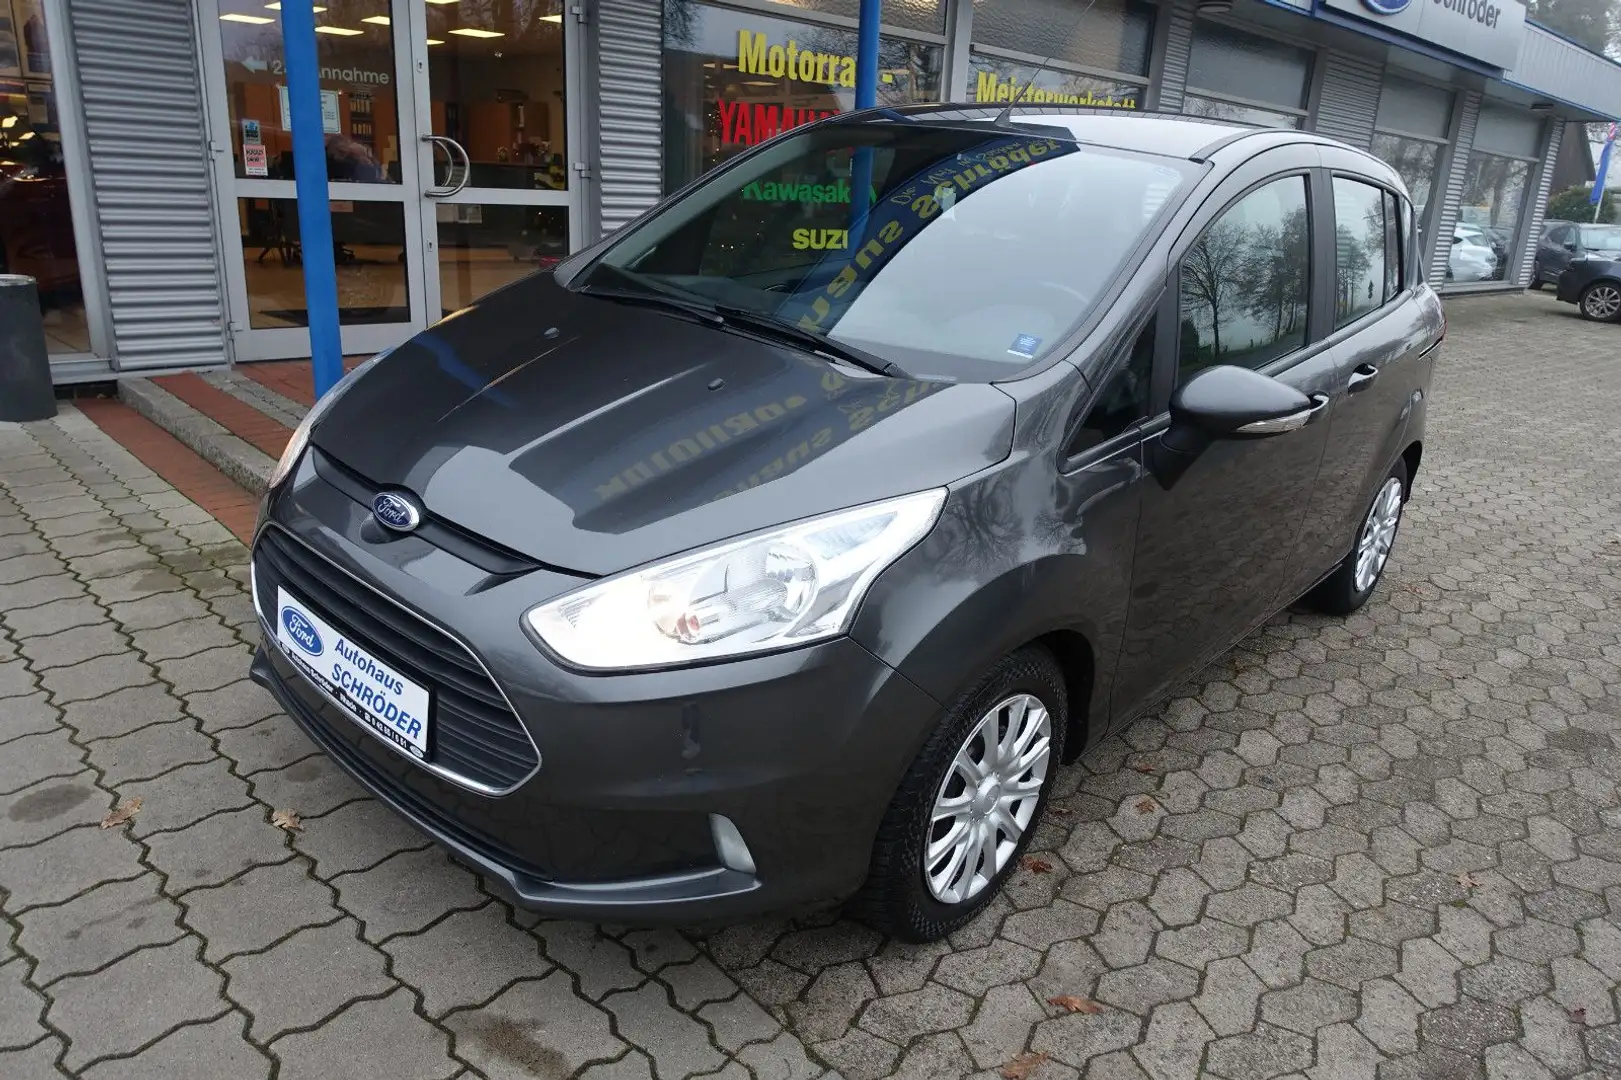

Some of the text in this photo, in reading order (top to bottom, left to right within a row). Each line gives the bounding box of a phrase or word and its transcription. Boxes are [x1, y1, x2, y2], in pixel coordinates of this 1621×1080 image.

[318, 66, 390, 86] nnahme
[718, 99, 840, 145] YAMA
[743, 178, 851, 203] Kawasak
[792, 228, 848, 250] SUZ
[288, 613, 315, 648] Ford
[335, 637, 404, 695] Autohaus
[332, 663, 422, 739] SCHRÖDER
